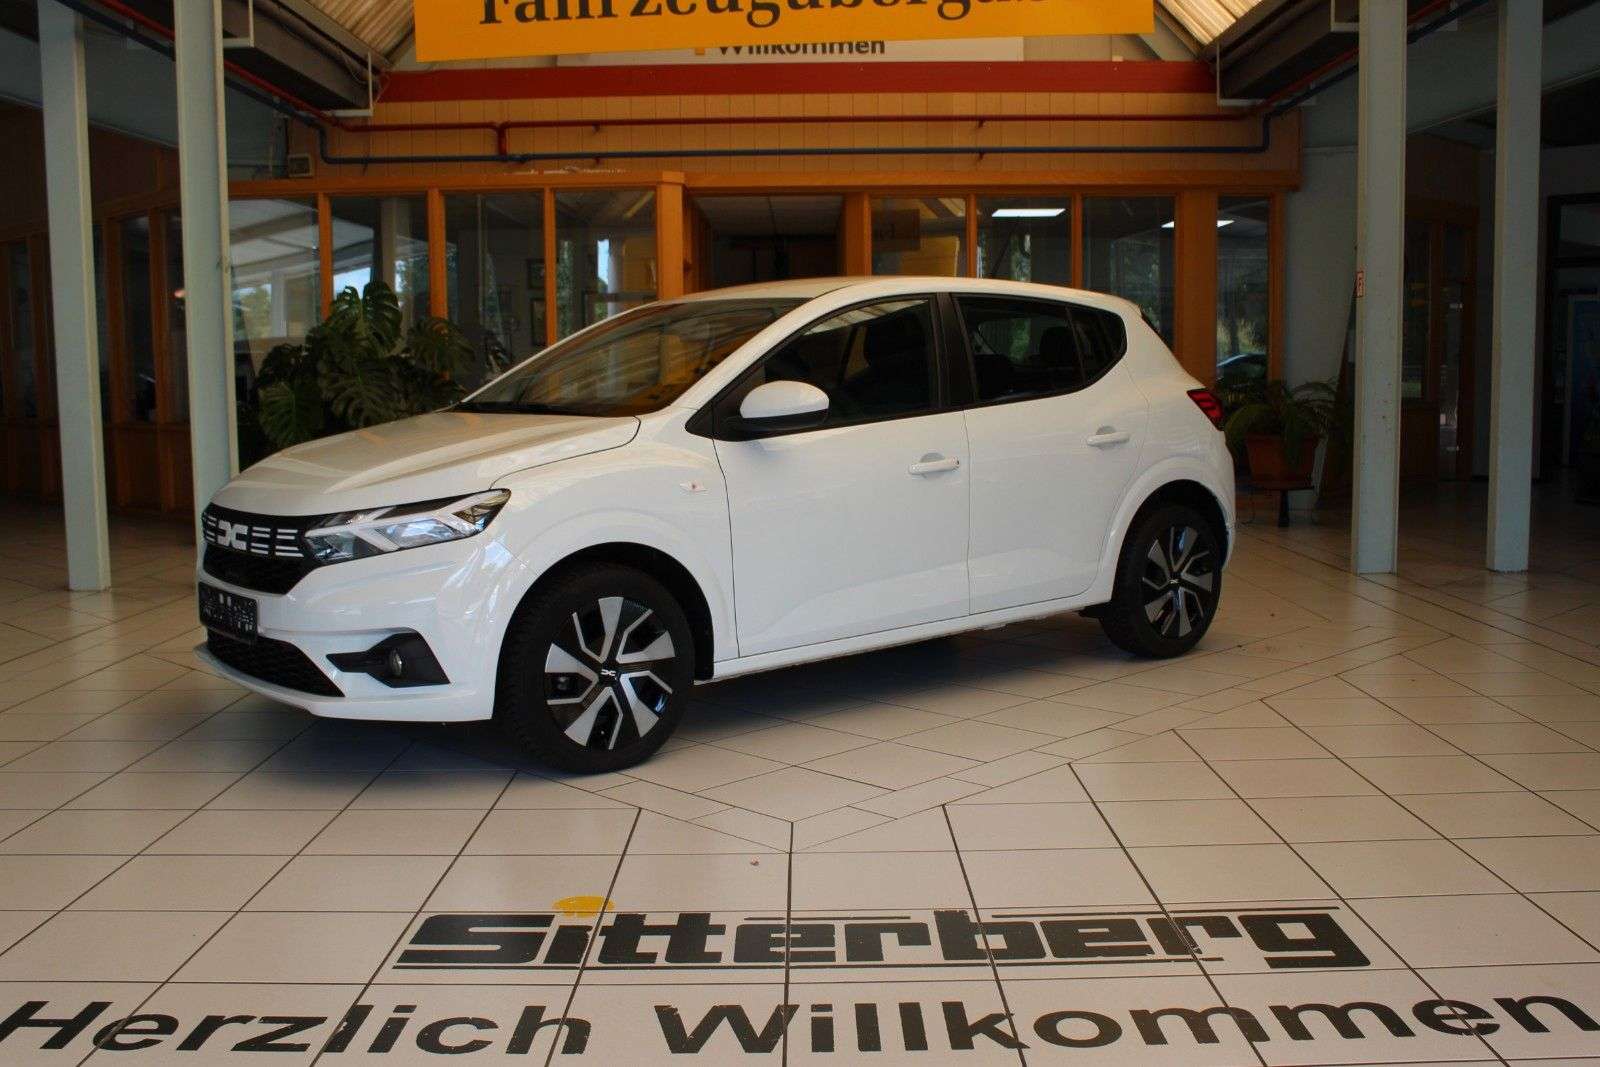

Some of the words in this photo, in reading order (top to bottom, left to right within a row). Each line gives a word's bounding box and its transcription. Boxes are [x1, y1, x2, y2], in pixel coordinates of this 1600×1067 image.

[396, 896, 1371, 968] Sitterberg
[0, 1000, 592, 1055] Herzlich
[653, 996, 1600, 1053] Willkommen
